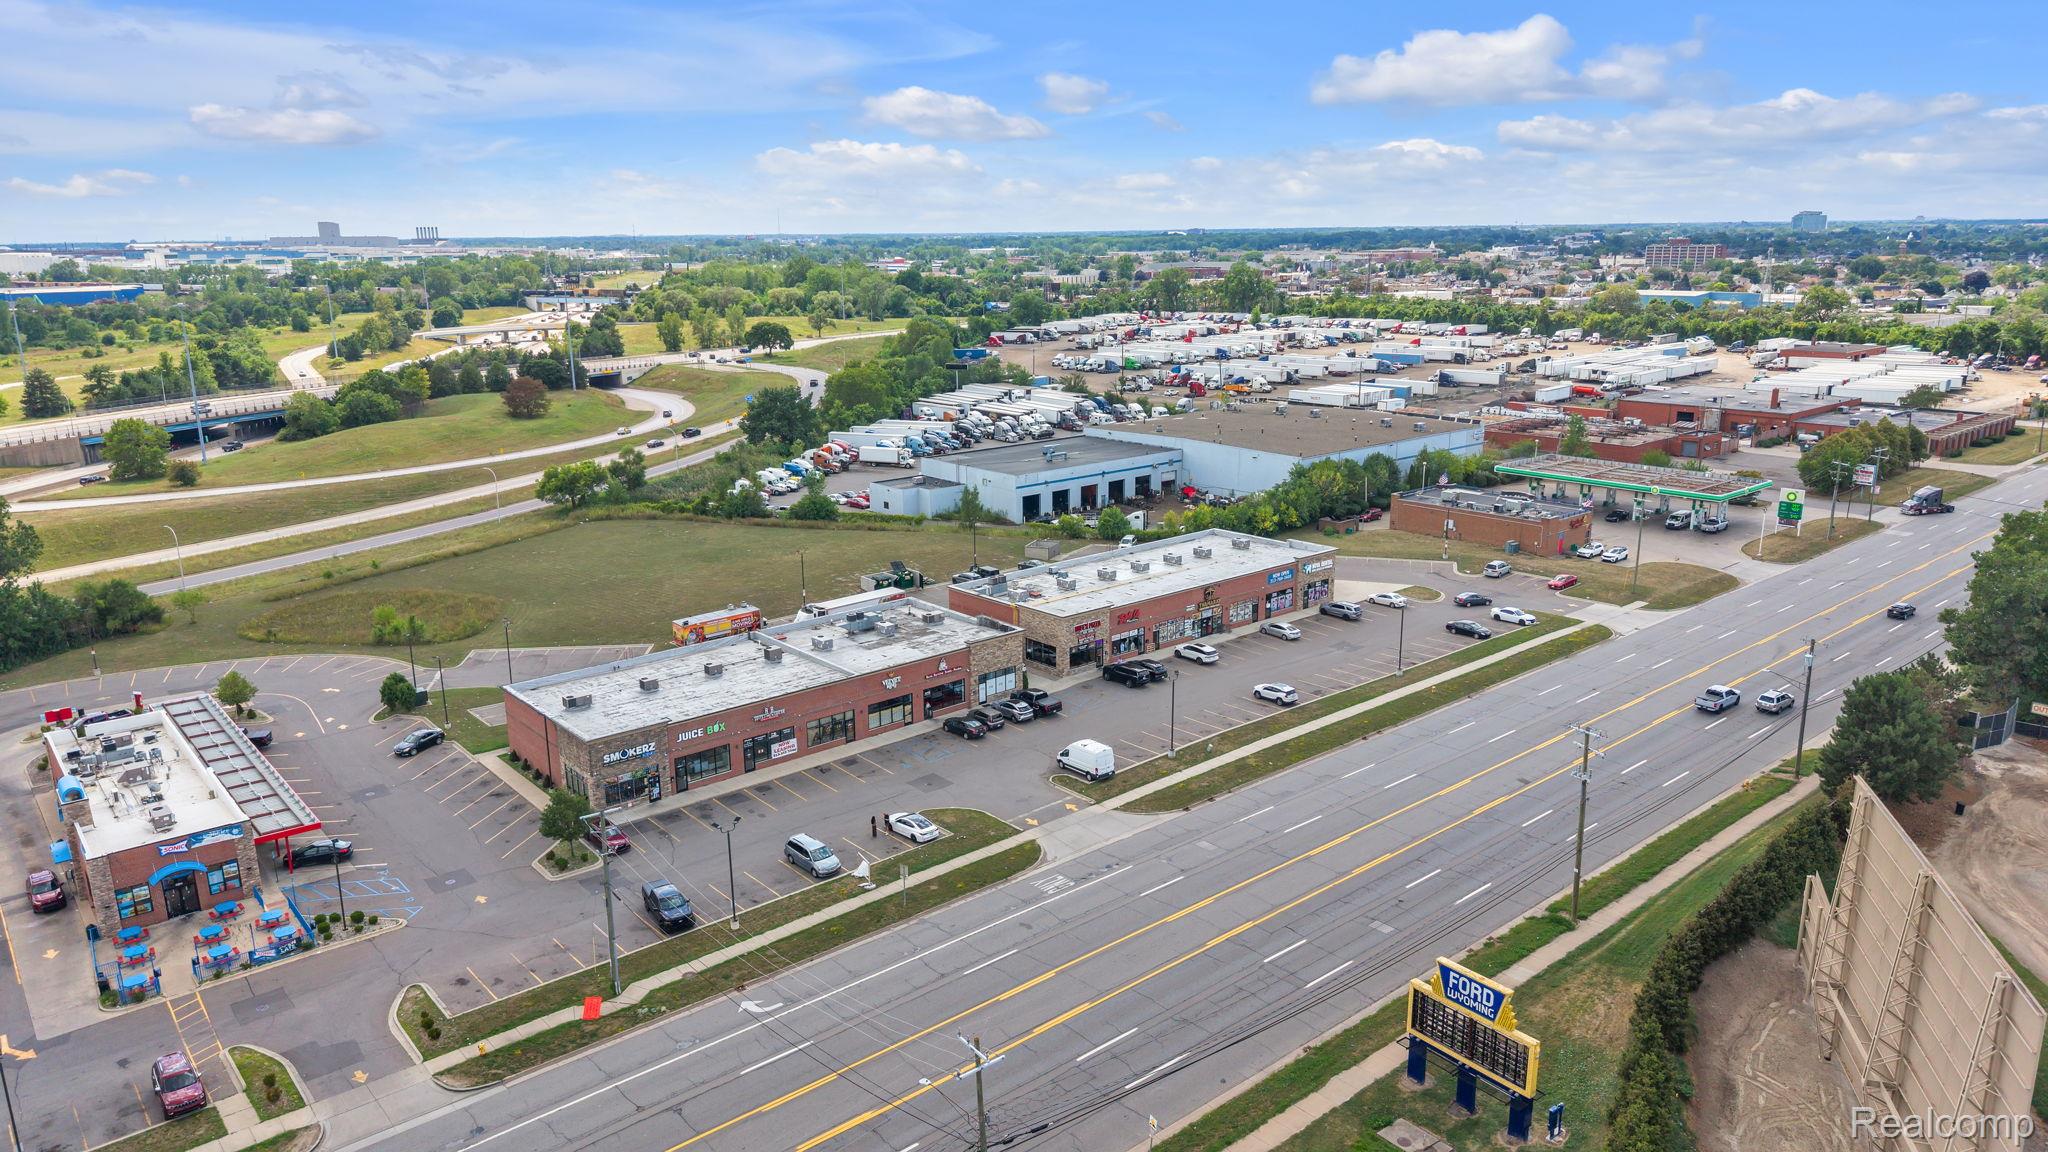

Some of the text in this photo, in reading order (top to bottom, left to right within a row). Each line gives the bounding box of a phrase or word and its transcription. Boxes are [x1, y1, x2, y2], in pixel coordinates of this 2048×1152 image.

[676, 720, 726, 743] JUICE BOX
[603, 741, 656, 763] SMOKERZ
[774, 744, 796, 753] LEASING
[163, 843, 185, 853] SONIC
[1449, 970, 1495, 1007] FORD
[1447, 986, 1495, 1019] WYOMING
